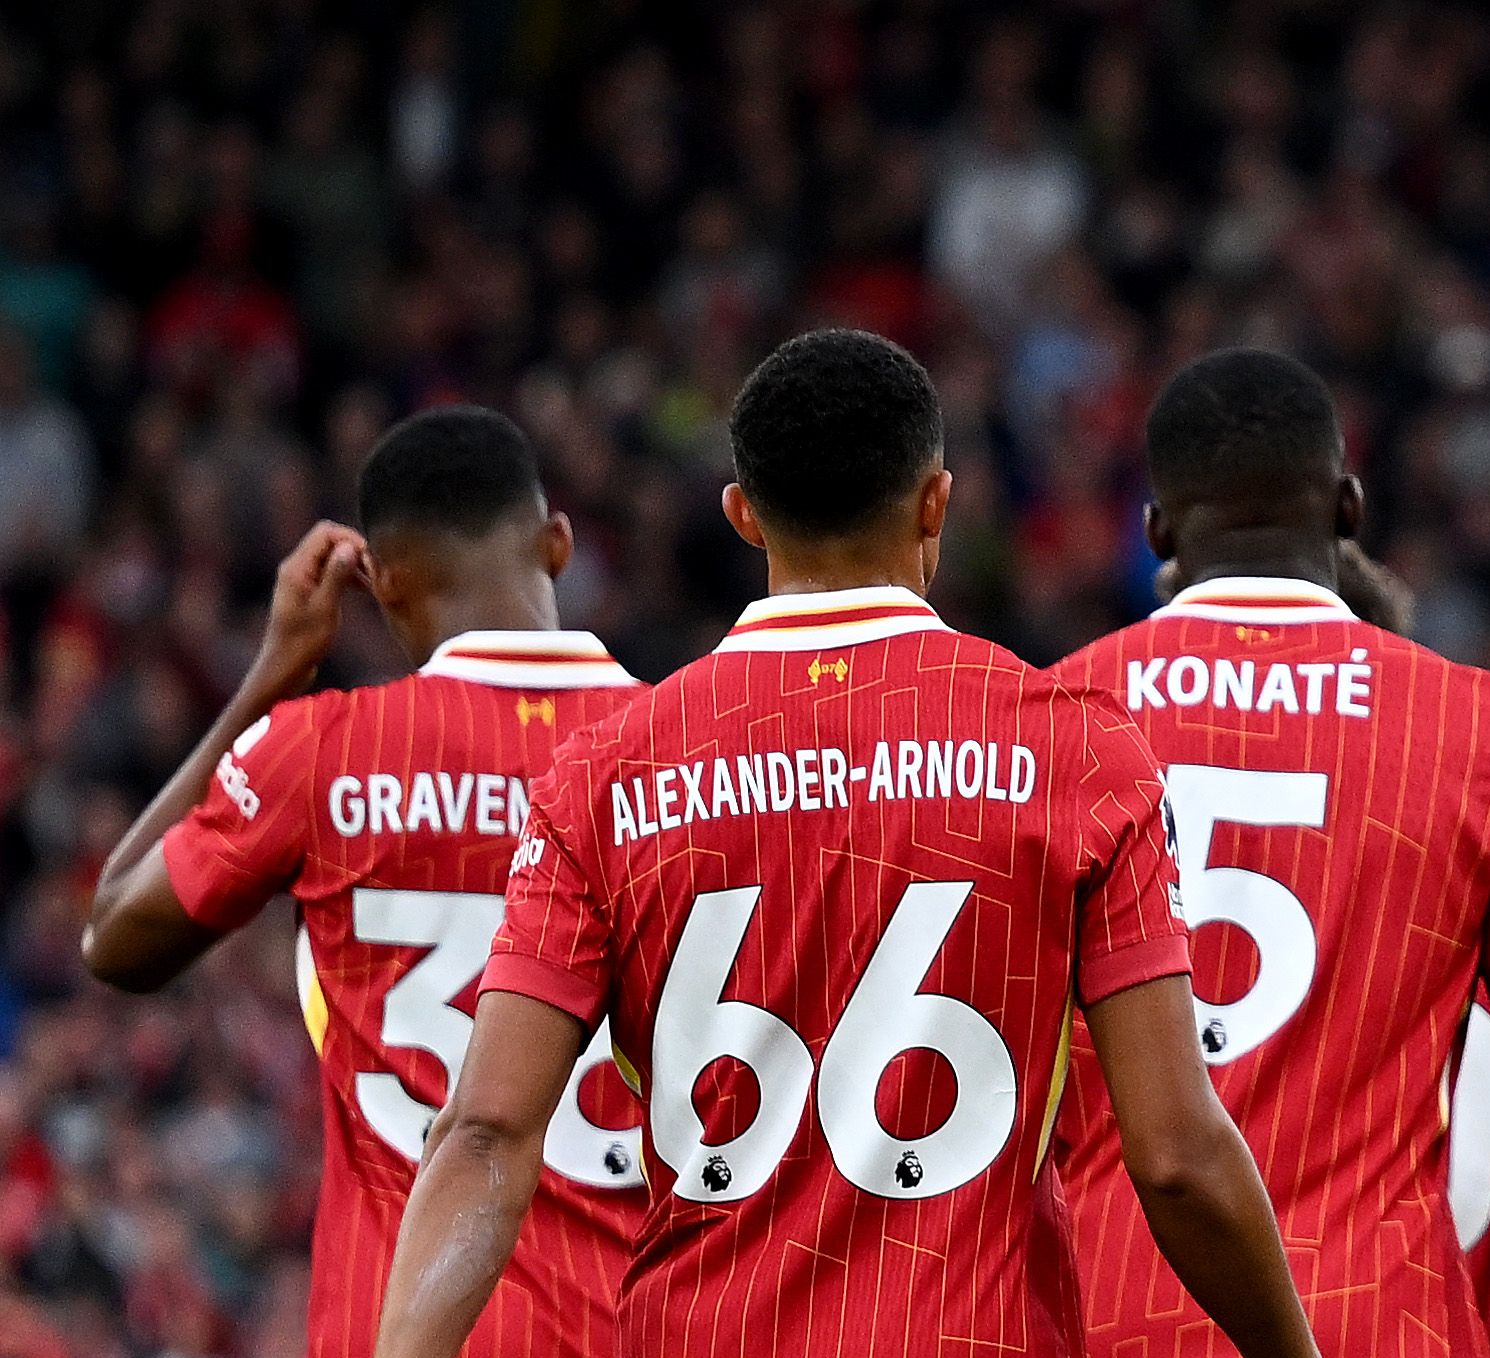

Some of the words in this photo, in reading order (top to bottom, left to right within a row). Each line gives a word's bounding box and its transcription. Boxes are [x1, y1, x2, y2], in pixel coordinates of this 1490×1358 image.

[1125, 647, 1373, 718] KONATÉ
[329, 772, 533, 837] GRAVEN
[611, 739, 1037, 847] ALEXANDER-ARNOLD
[1166, 763, 1329, 1066] 5
[650, 881, 1018, 1202] 66
